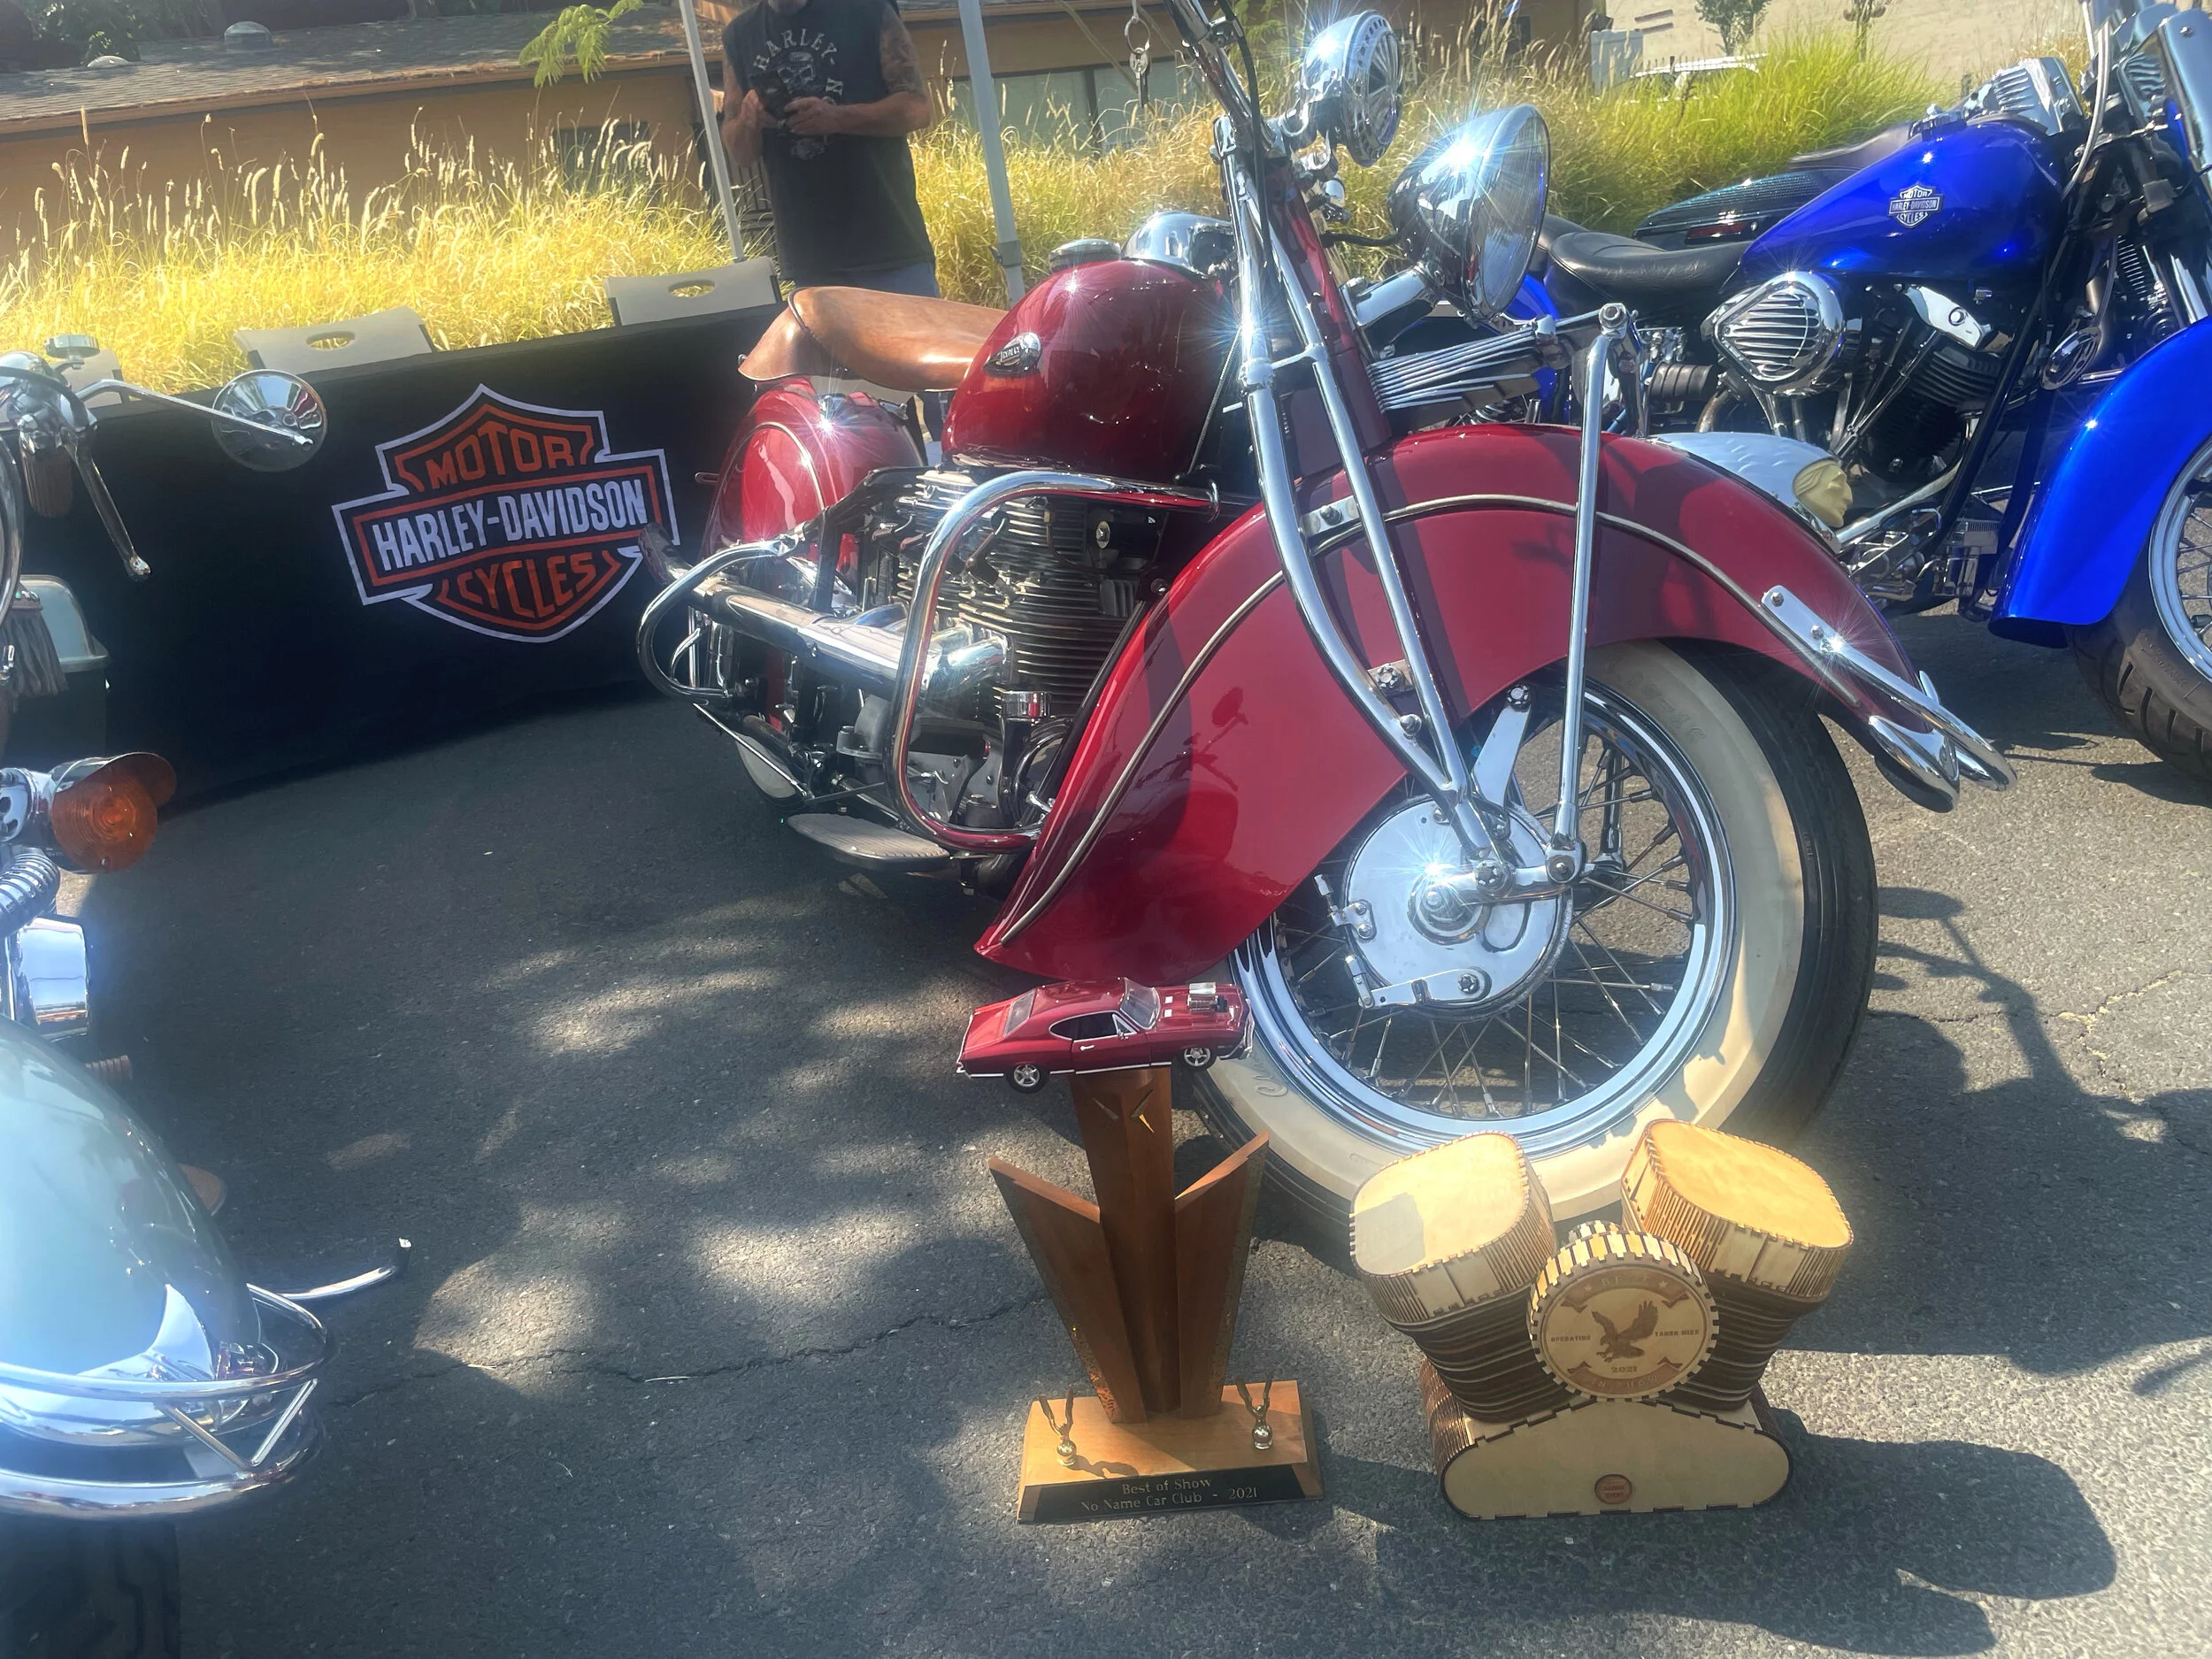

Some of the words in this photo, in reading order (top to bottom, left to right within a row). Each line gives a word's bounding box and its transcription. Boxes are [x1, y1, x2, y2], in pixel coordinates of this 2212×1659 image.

[1903, 188, 1928, 199] MOTOR
[1892, 199, 1937, 211] HARLEY-DAVIDSON
[1900, 211, 1924, 223] CYCLES
[426, 420, 578, 489] MOTOR
[372, 479, 648, 572] HARLEY-DAVIDSON
[457, 551, 596, 618] CYCLES
[1123, 1482, 1151, 1495] Best
[1156, 1479, 1170, 1494] of
[1174, 1478, 1212, 1491] Show
[1081, 1501, 1099, 1512] No
[1104, 1497, 1141, 1510] Name
[1146, 1494, 1168, 1508] Car
[1171, 1491, 1203, 1505] Club
[1228, 1486, 1258, 1501] 2021
